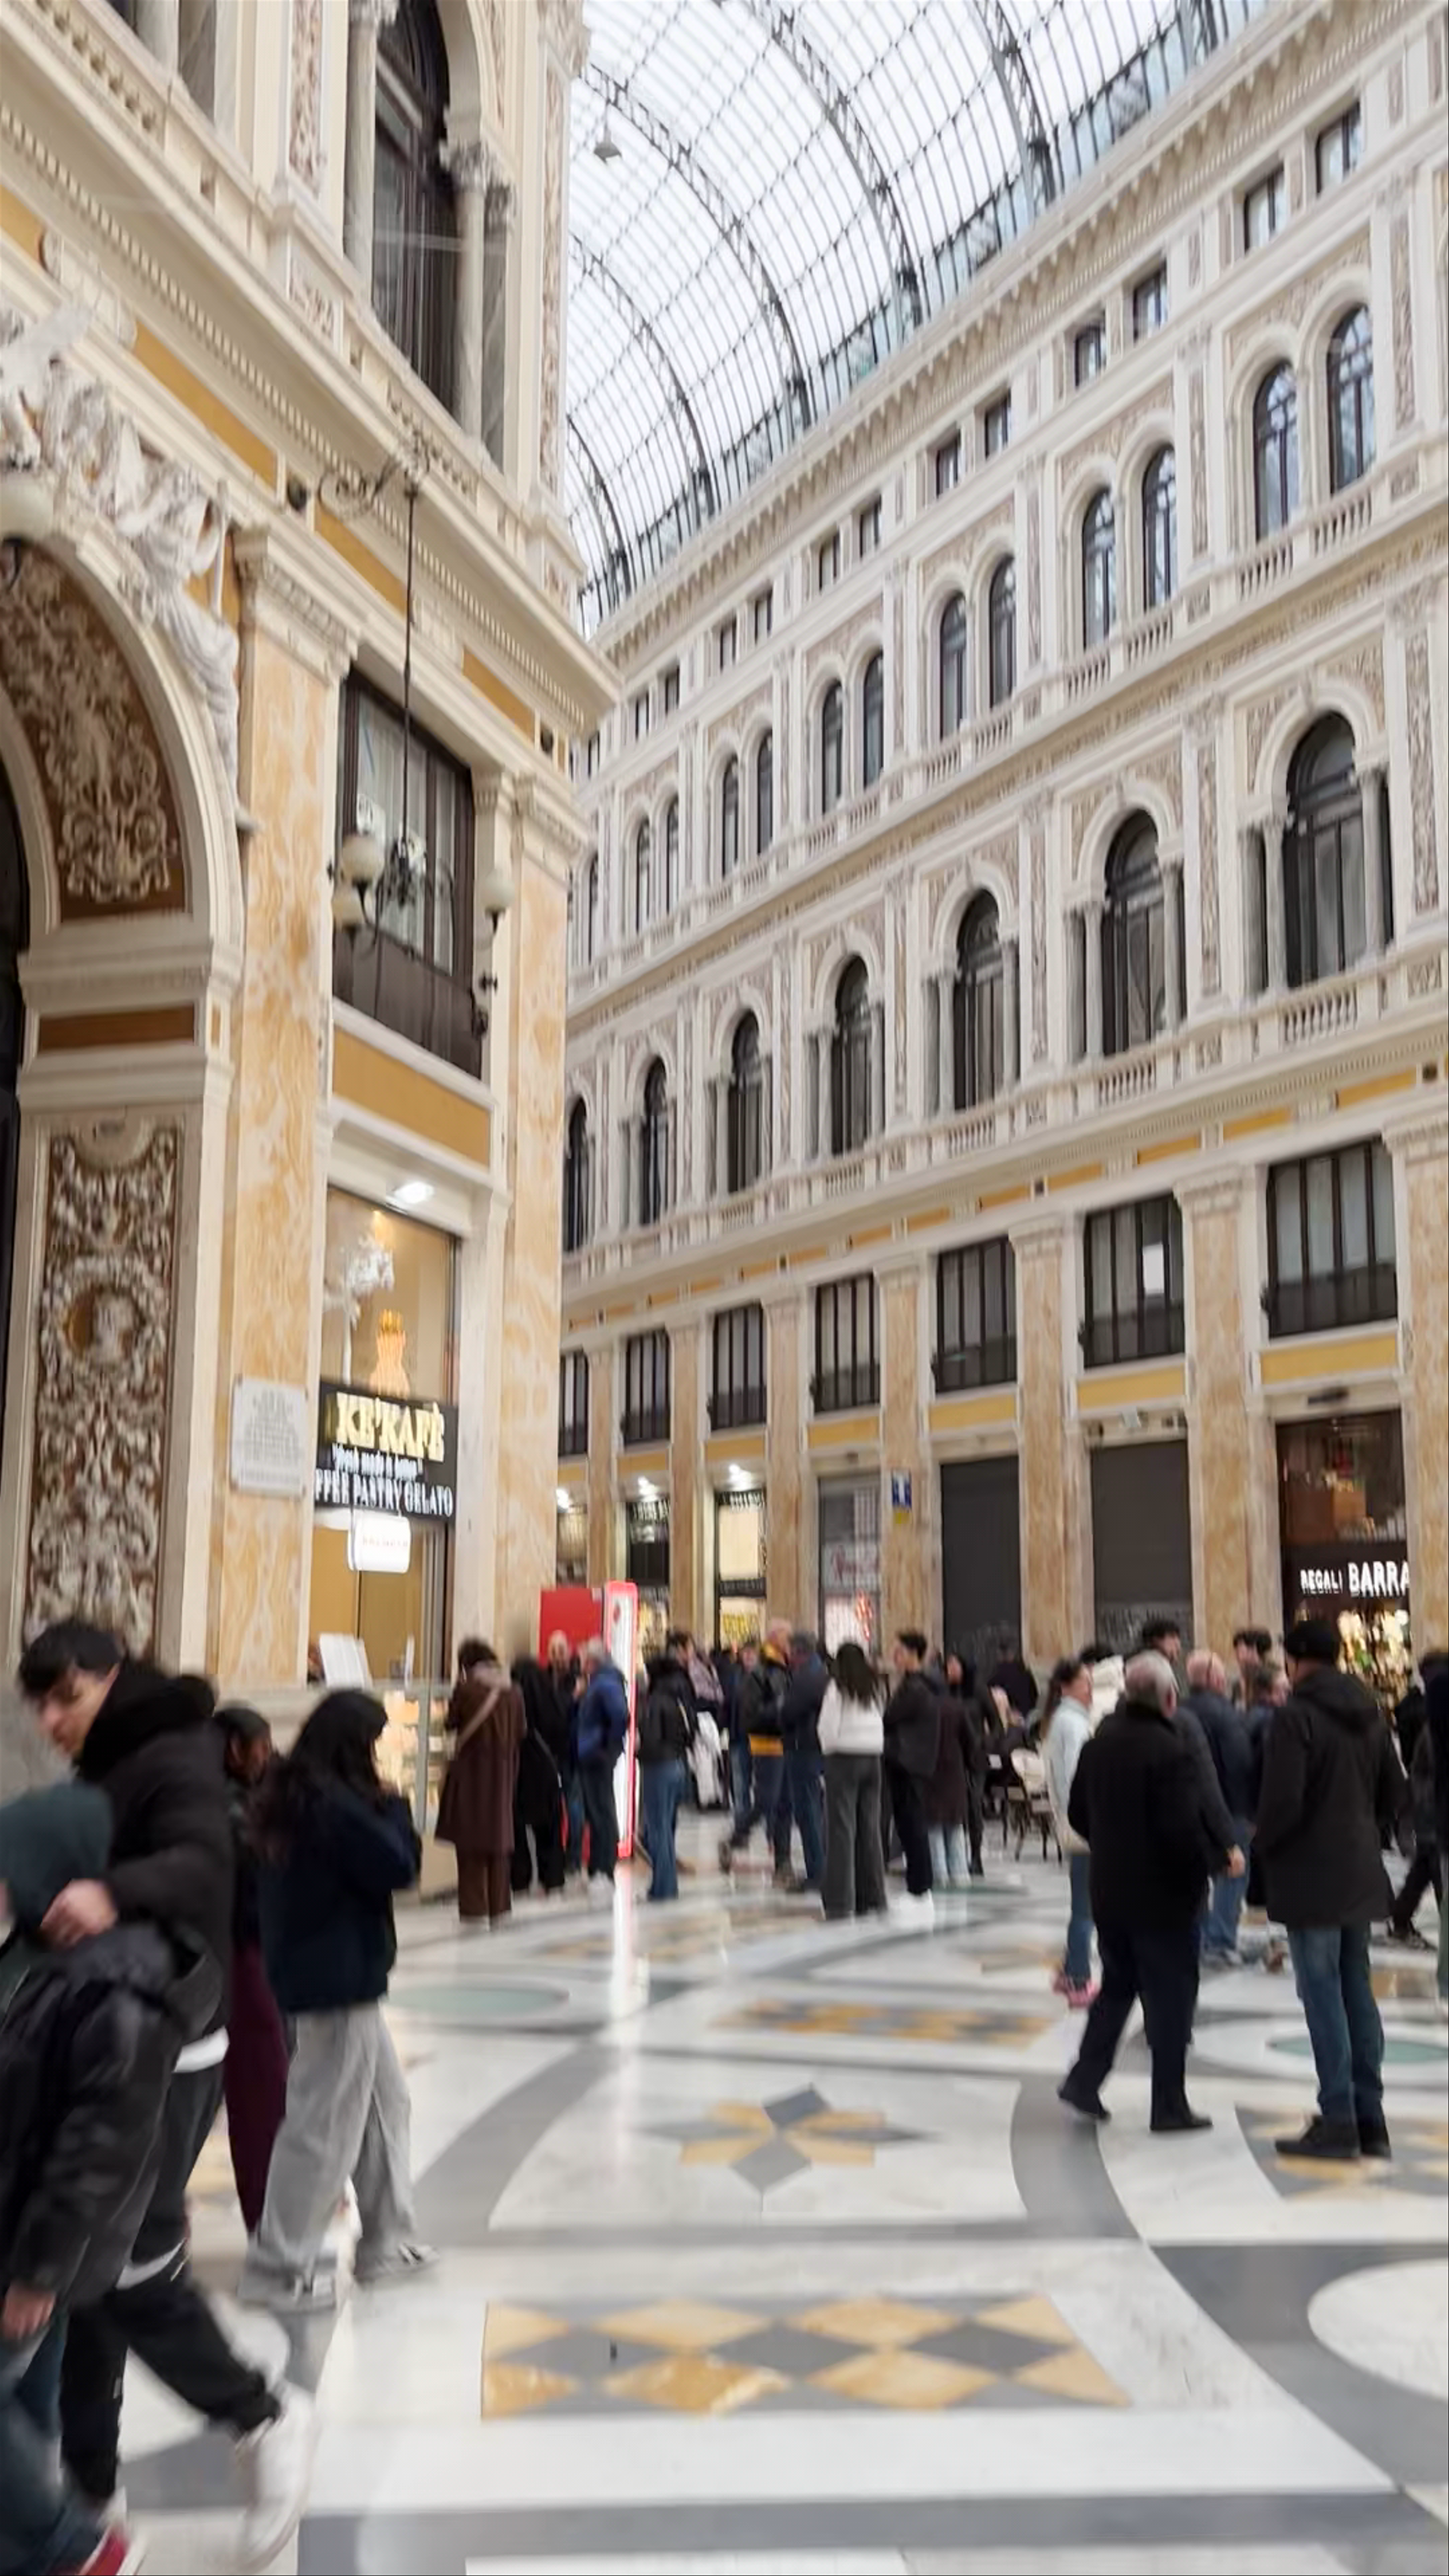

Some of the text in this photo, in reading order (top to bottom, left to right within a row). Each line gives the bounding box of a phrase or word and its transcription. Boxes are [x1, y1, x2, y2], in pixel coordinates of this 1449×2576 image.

[354, 1473, 402, 1510] PASTRY
[404, 1480, 452, 1517] GELATO
[1300, 1570, 1343, 1592] REGALI
